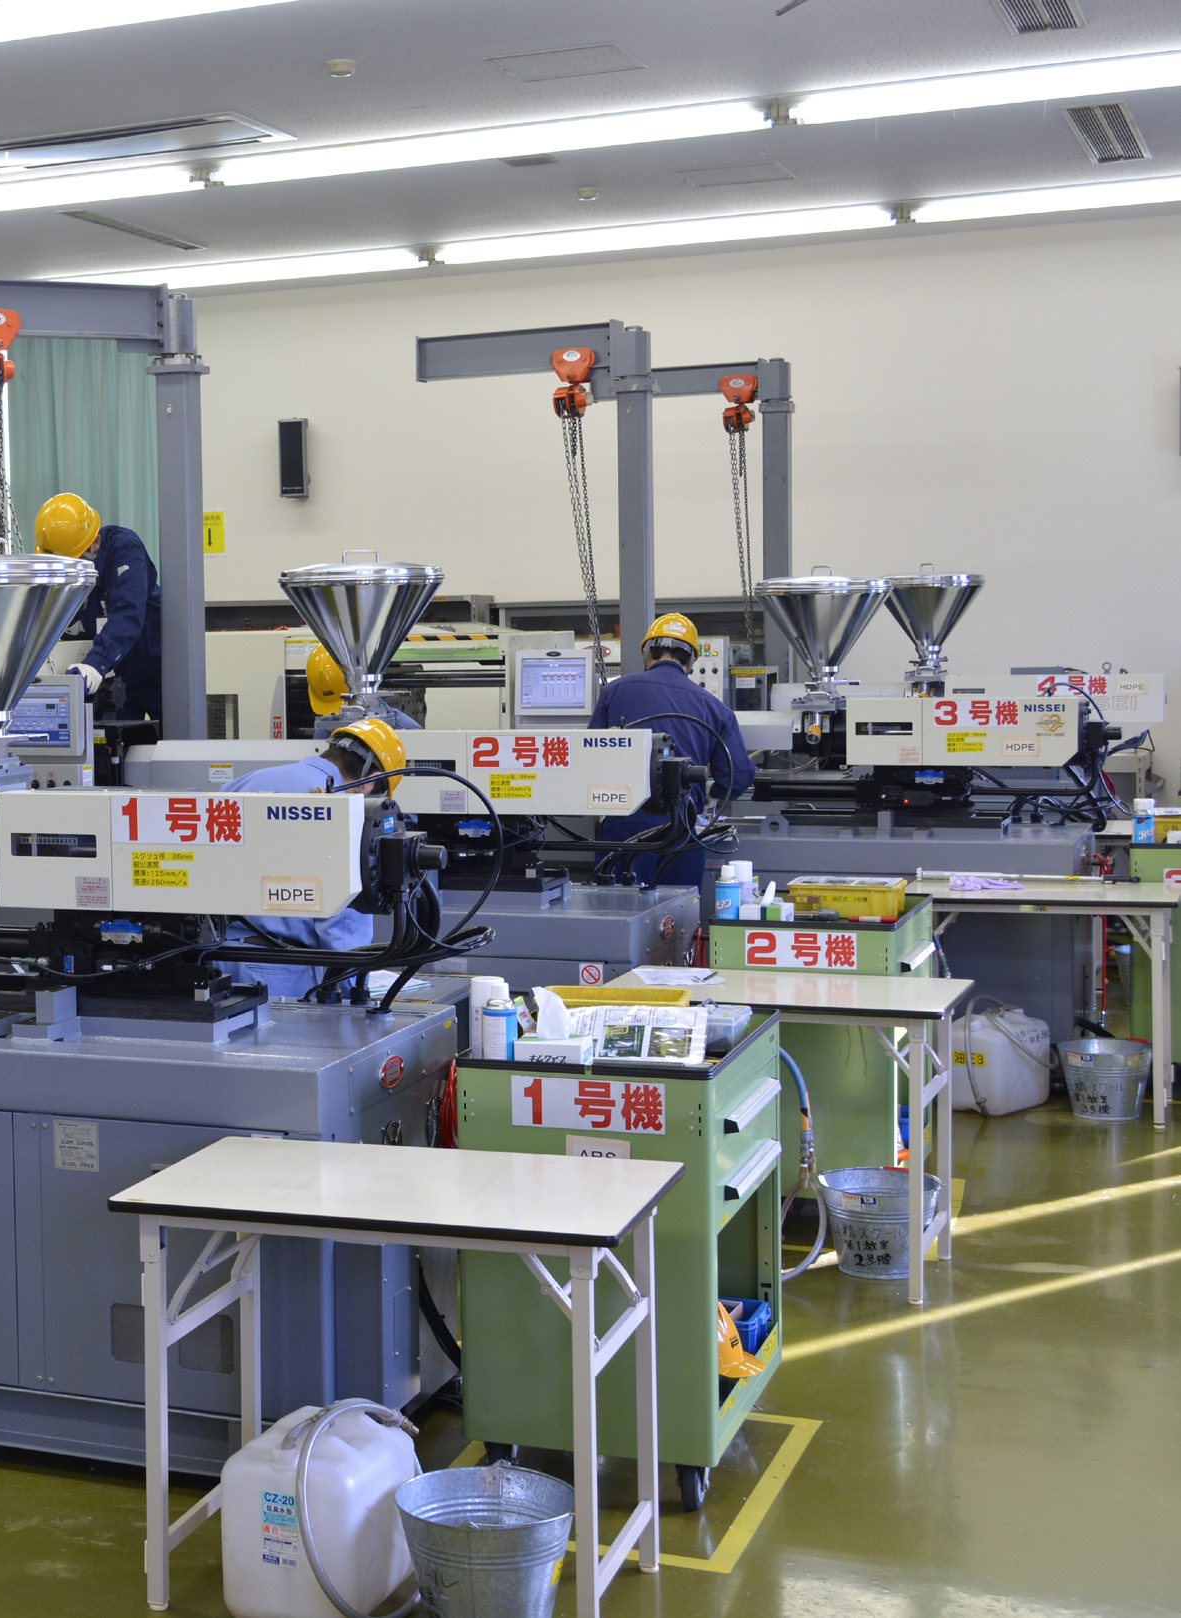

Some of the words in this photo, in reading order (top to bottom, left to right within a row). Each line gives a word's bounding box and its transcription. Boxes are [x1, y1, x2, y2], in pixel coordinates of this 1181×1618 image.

[1119, 683, 1145, 691] HDPE
[934, 700, 1019, 726] 3号機
[1023, 703, 1066, 712] NISSEI
[583, 737, 632, 748] NISSEI
[1005, 743, 1035, 752] HDPE
[473, 736, 570, 768] 2号機
[592, 793, 627, 803] HDPE
[122, 797, 242, 843] 1号機
[267, 806, 332, 821] NISSEI
[268, 888, 315, 902] HDPE
[747, 932, 856, 968] 2号機
[523, 1078, 663, 1132] 1号機
[264, 1492, 295, 1506] CZ-20
